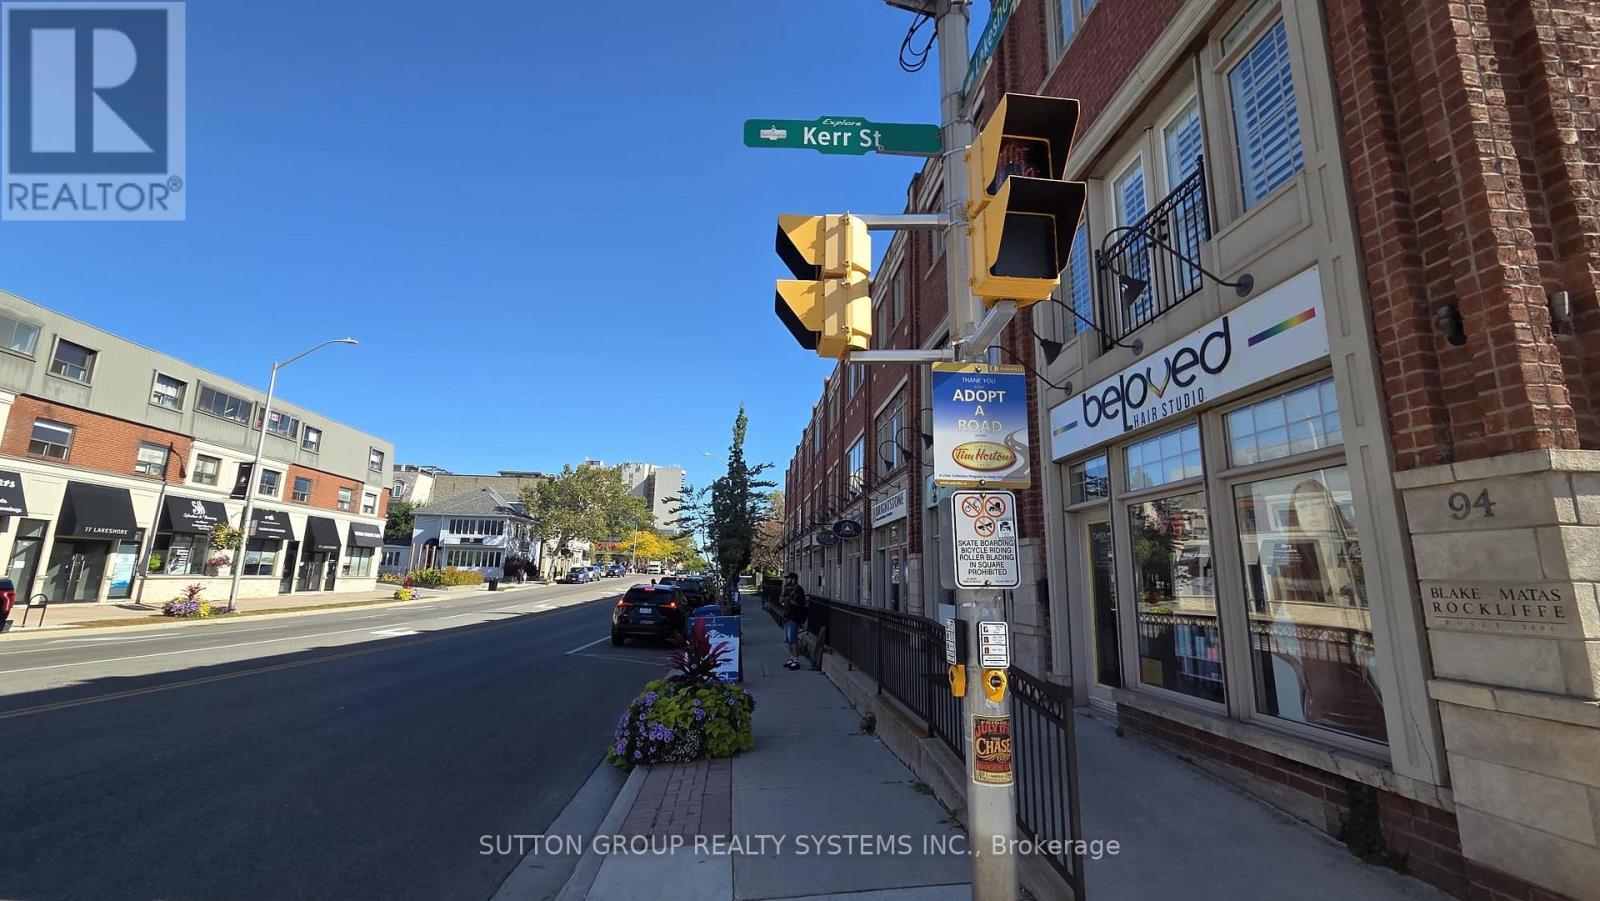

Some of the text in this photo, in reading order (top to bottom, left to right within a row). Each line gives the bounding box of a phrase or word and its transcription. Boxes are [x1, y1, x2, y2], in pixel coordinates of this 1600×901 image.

[822, 118, 862, 127] Explore
[803, 126, 882, 147] Kerr St
[1082, 315, 1232, 432] beloved
[952, 389, 1006, 403] ADOPT
[974, 405, 985, 416] A
[1133, 406, 1158, 428] HAIR
[958, 419, 1003, 432] ROAD
[956, 448, 1015, 461] Tim Hortons
[1448, 487, 1497, 521] 94
[93, 527, 128, 535] LAKESHORE
[977, 561, 1005, 569] SQUARE
[1430, 587, 1562, 602] BLAKE MATAS
[1432, 602, 1566, 619] ROCKLIFFE
[975, 737, 1011, 756] CHASE
